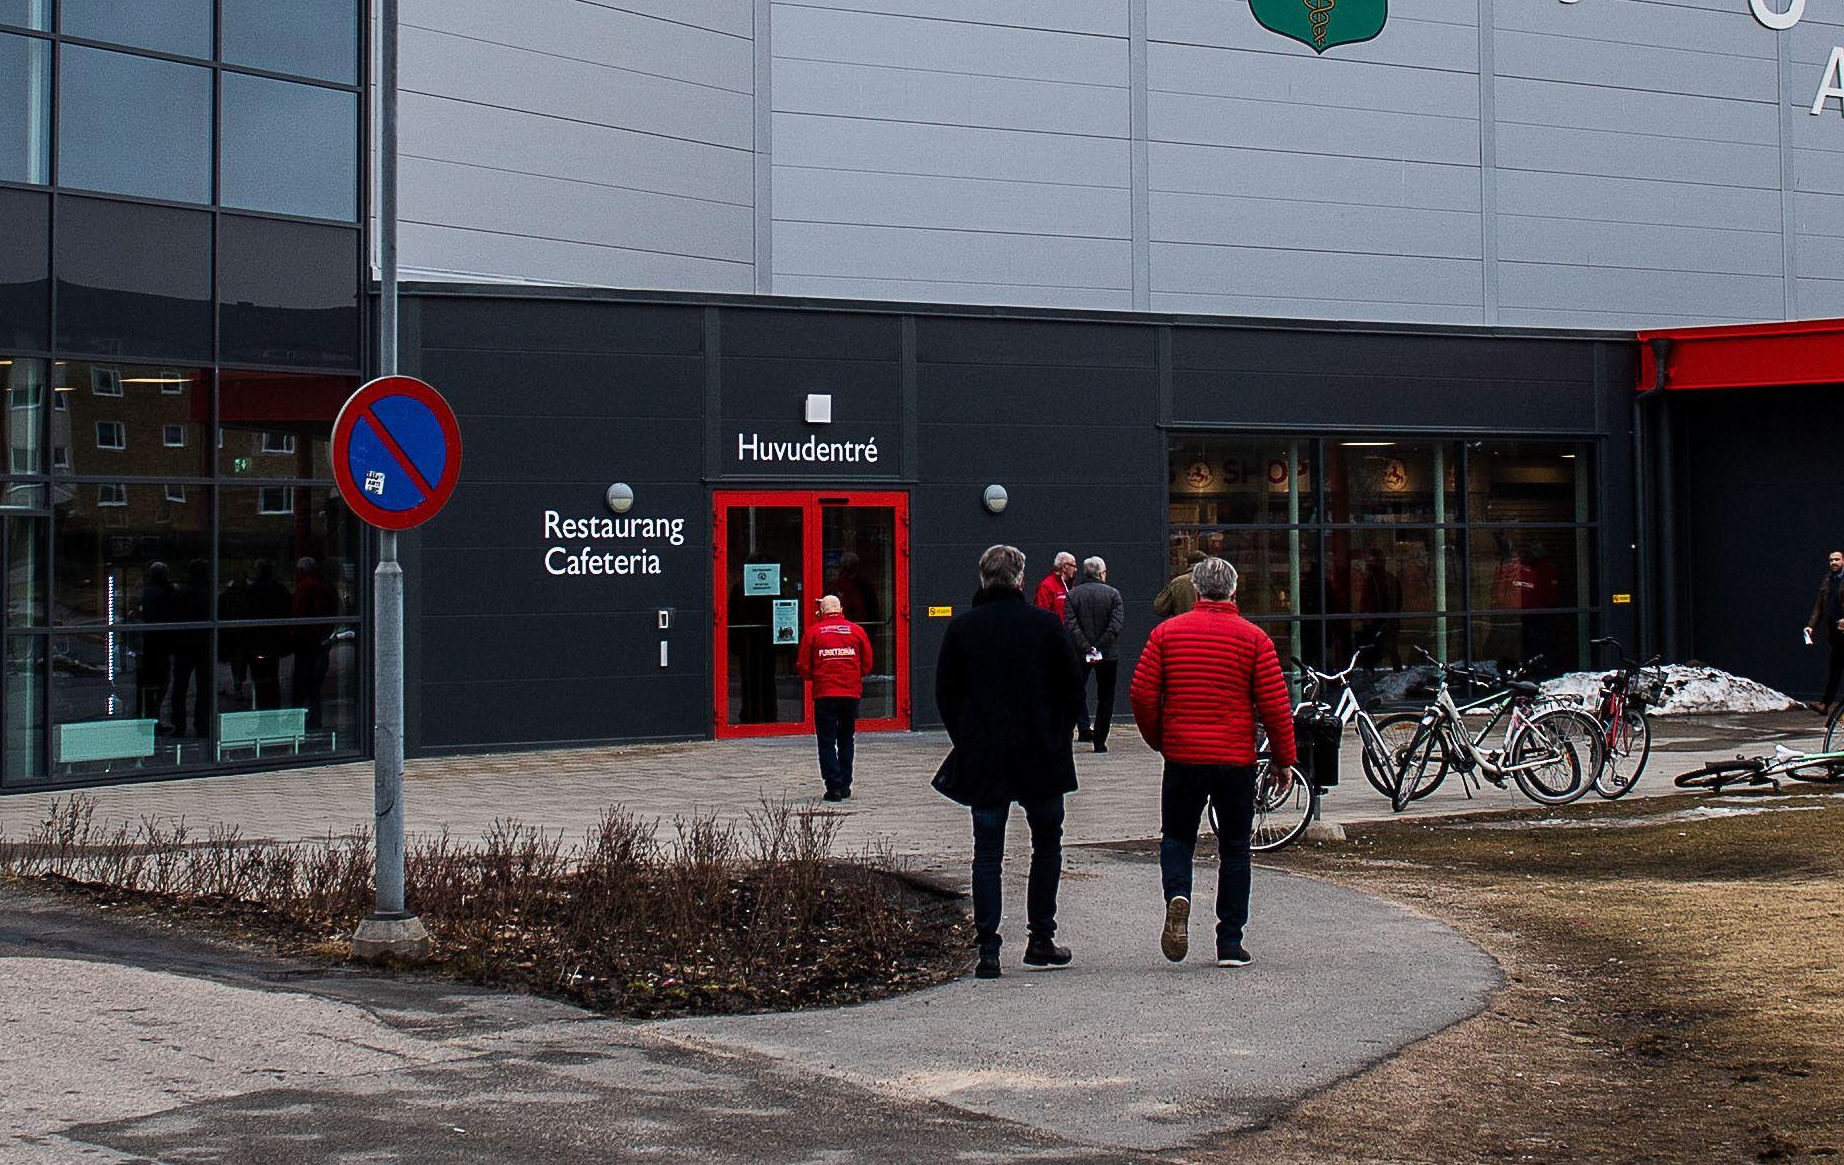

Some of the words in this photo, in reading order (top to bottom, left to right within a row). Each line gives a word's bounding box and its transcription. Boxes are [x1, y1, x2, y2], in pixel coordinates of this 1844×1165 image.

[738, 433, 878, 462] Huvudentré
[543, 510, 685, 546] Restaurang
[544, 546, 662, 575] Cafeteria
